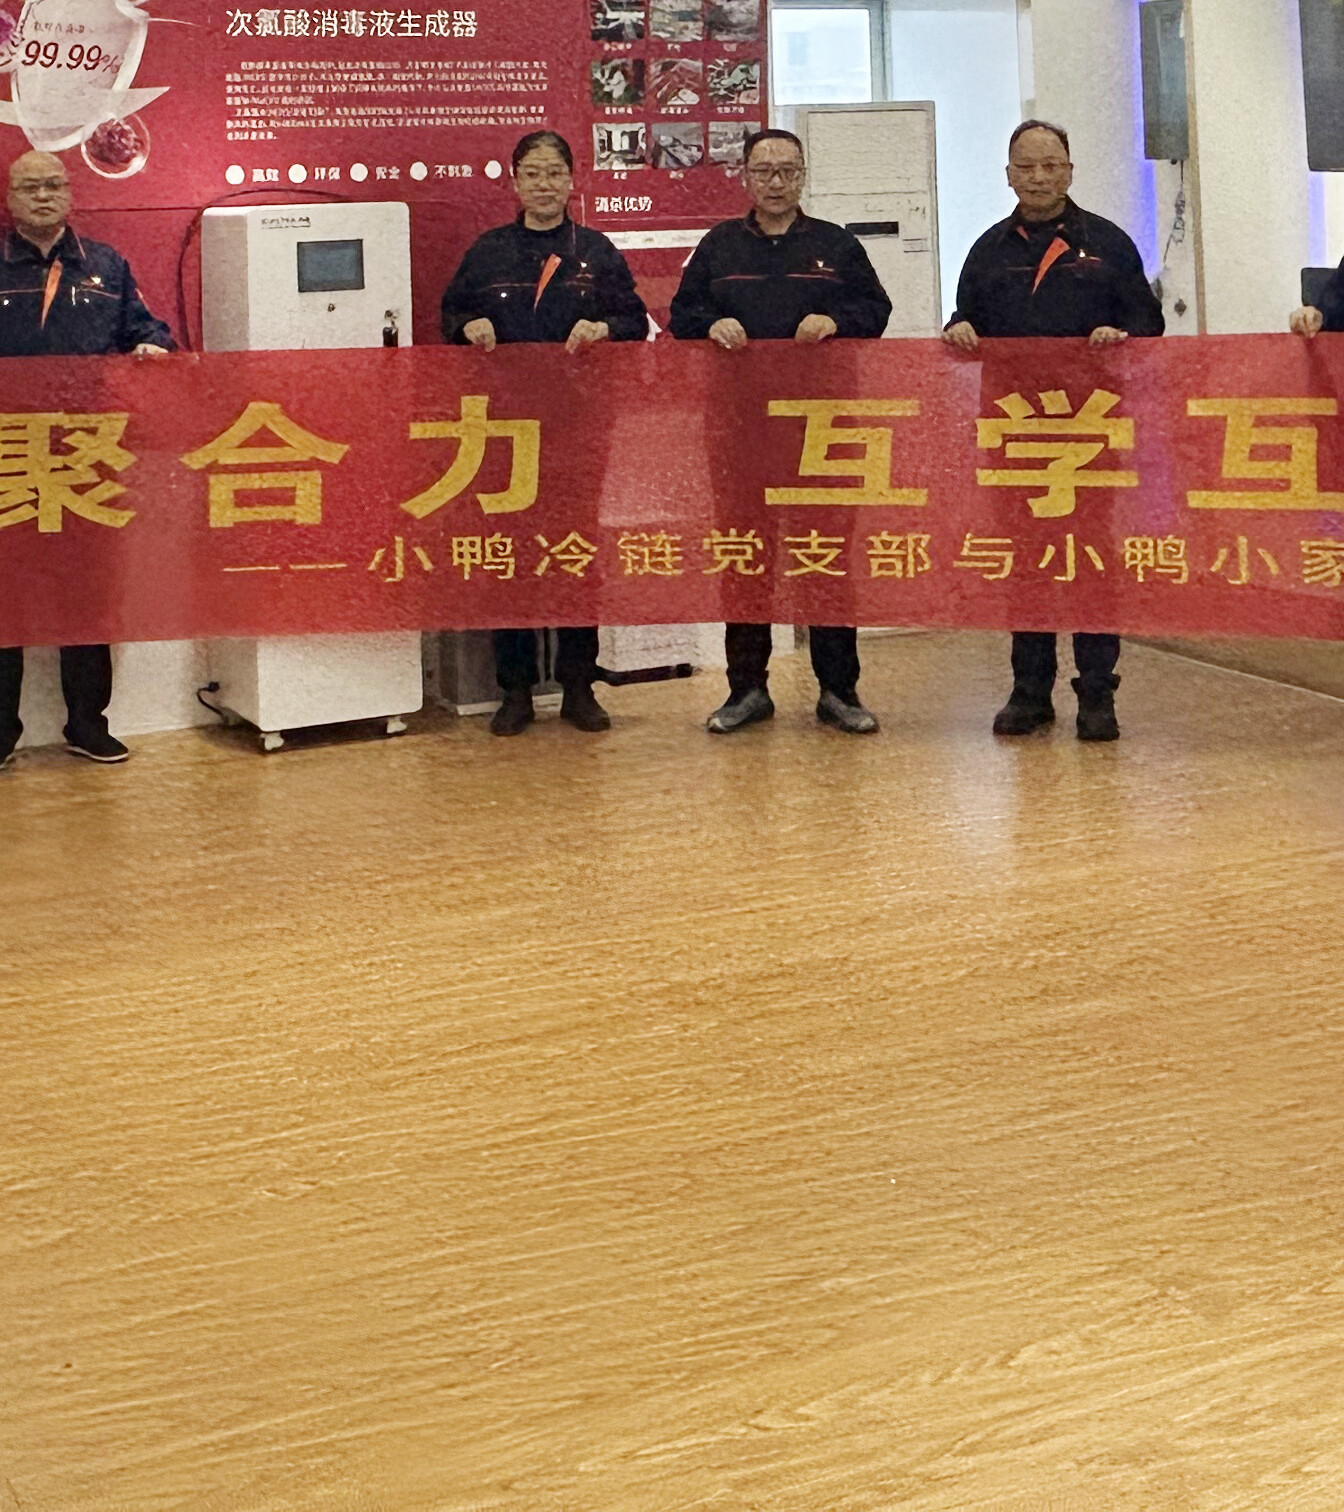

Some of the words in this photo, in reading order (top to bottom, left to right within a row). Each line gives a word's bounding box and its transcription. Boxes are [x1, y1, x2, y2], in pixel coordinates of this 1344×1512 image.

[225, 8, 478, 38] 次氯酸消毒液生成器
[20, 39, 121, 75] 99.99%
